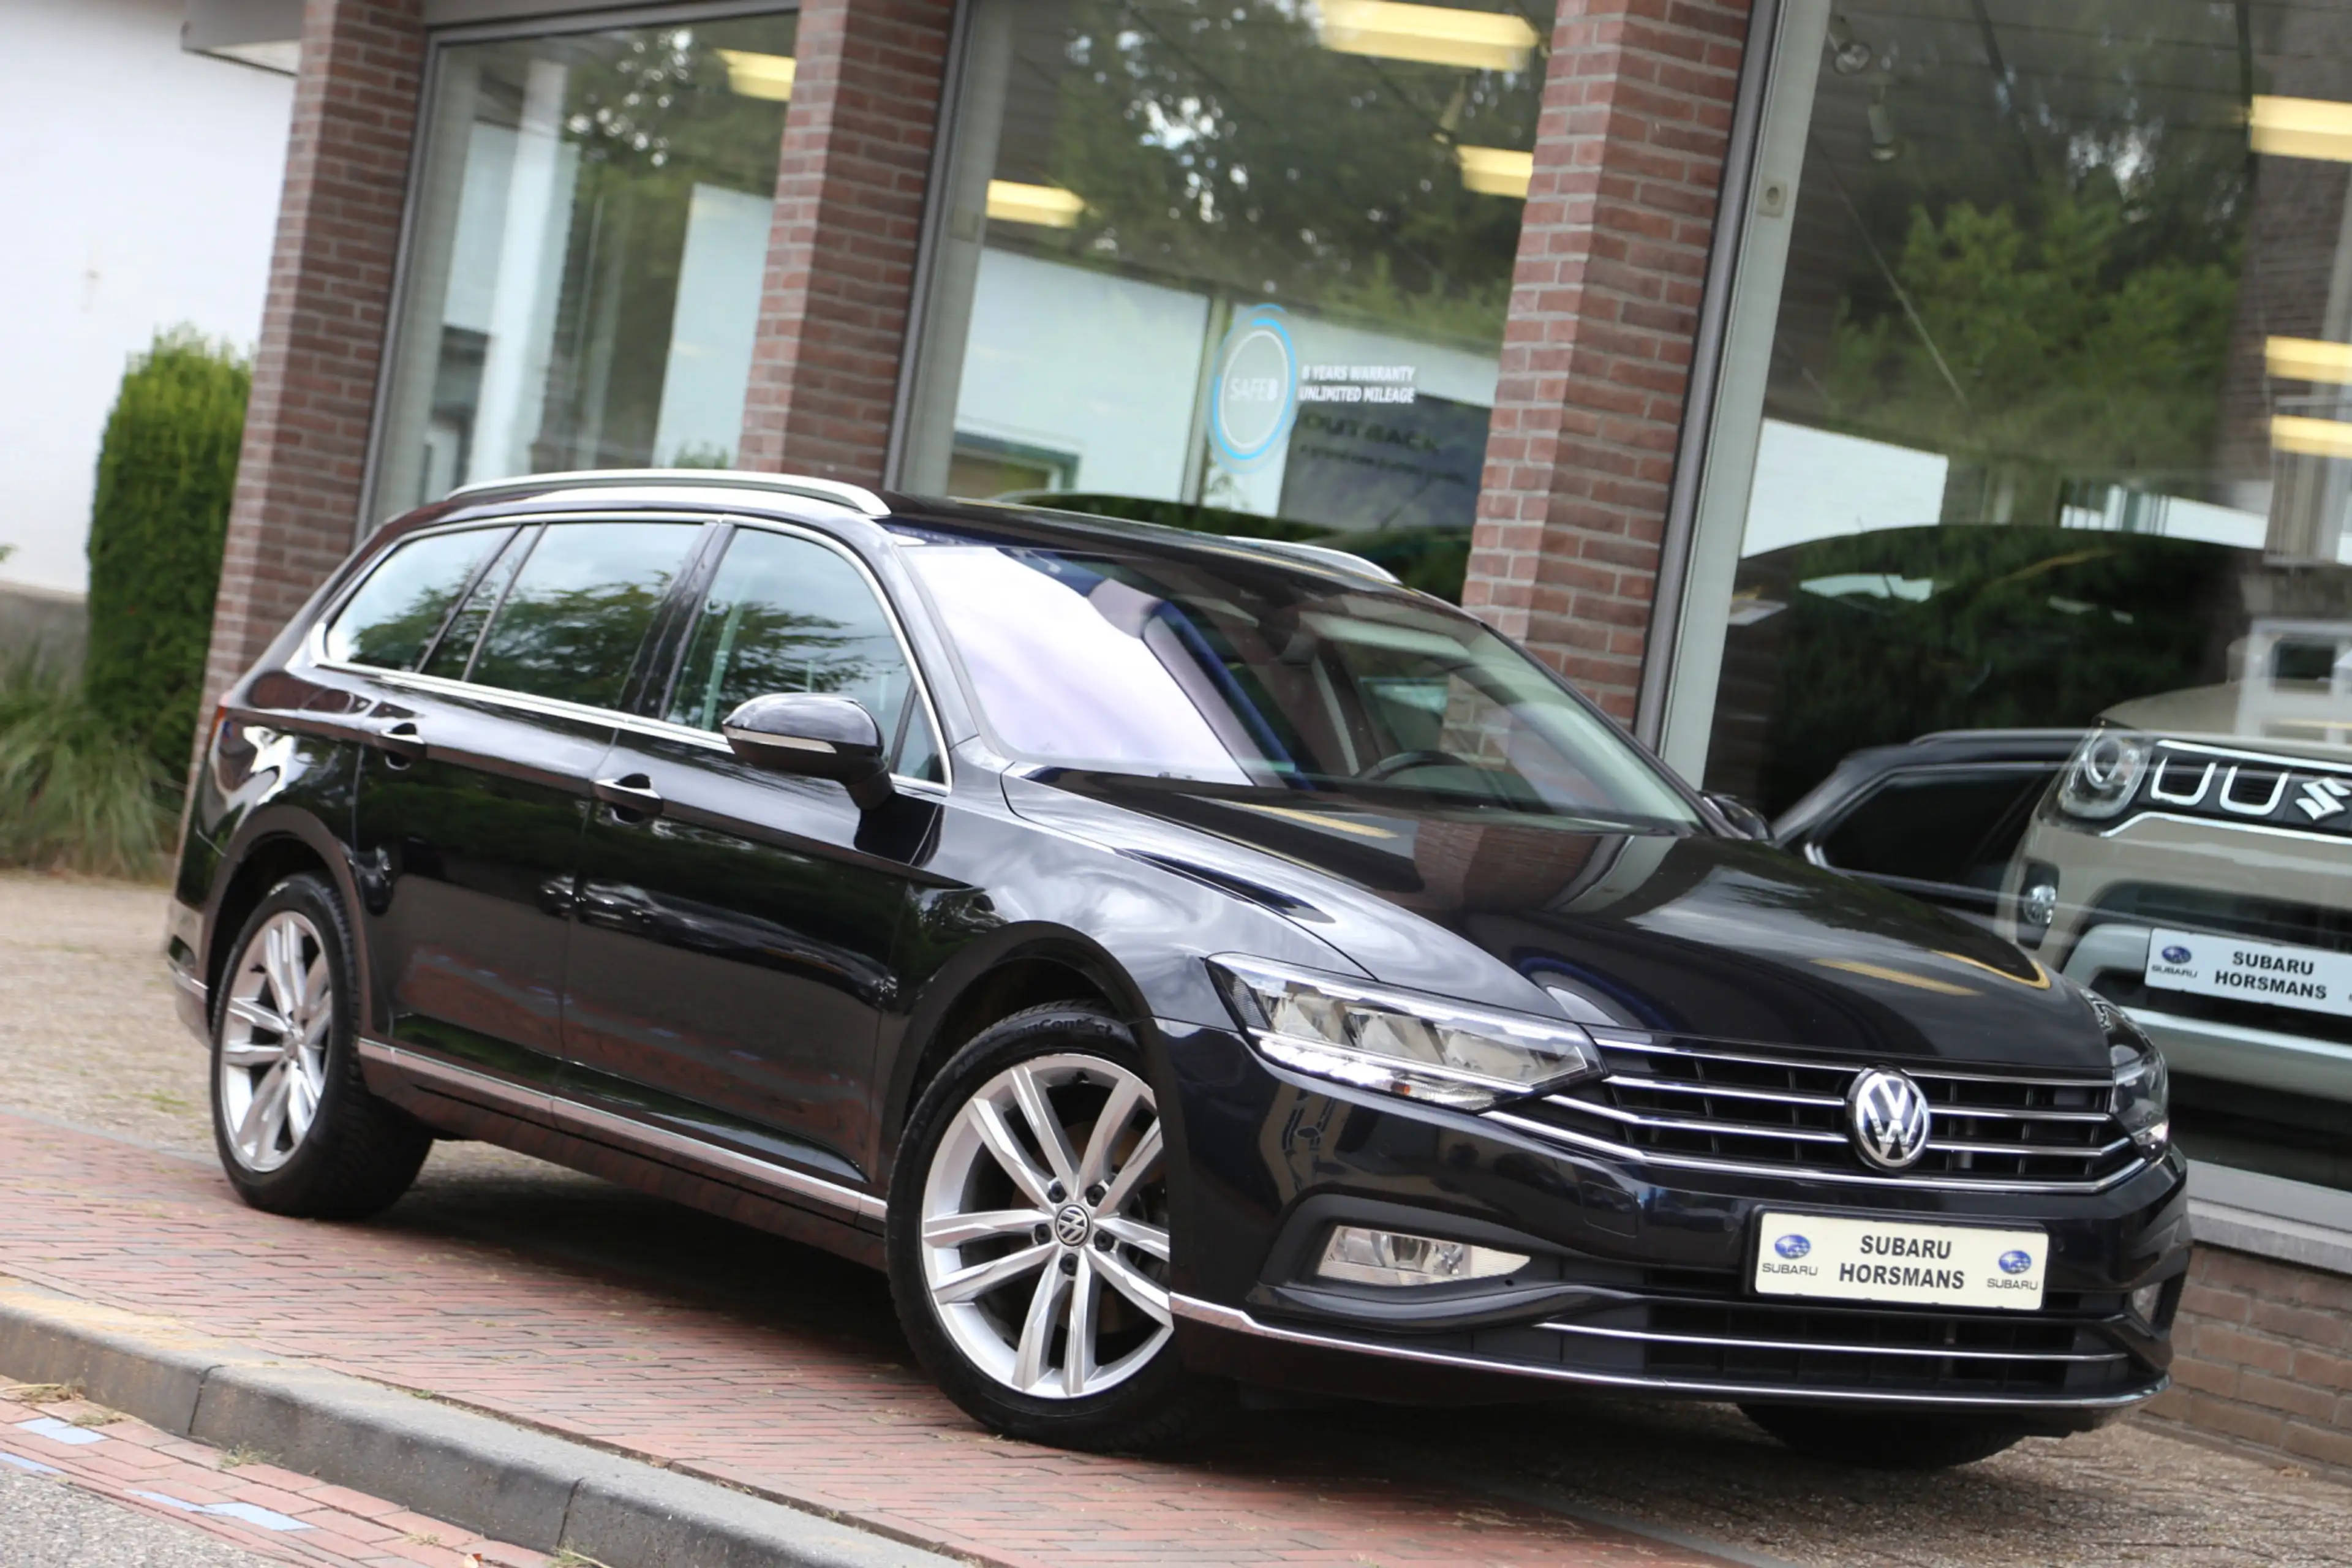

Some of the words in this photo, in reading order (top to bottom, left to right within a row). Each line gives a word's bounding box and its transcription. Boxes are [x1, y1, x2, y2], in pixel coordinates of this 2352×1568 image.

[1313, 366, 1347, 381] YEARS
[1349, 366, 1416, 382] WARRANTY
[1298, 385, 1362, 402] UNLIMITED
[1363, 386, 1415, 403] MILEAGE
[2152, 964, 2198, 978] SUBARU
[2233, 951, 2314, 975] SUBARU
[2214, 970, 2327, 1000] HORSMANS
[1860, 1235, 1951, 1259] SUBARU
[1762, 1263, 1818, 1276] SUBARU
[1839, 1263, 1964, 1289] HORSMANS
[1987, 1278, 2038, 1291] SUBARU
